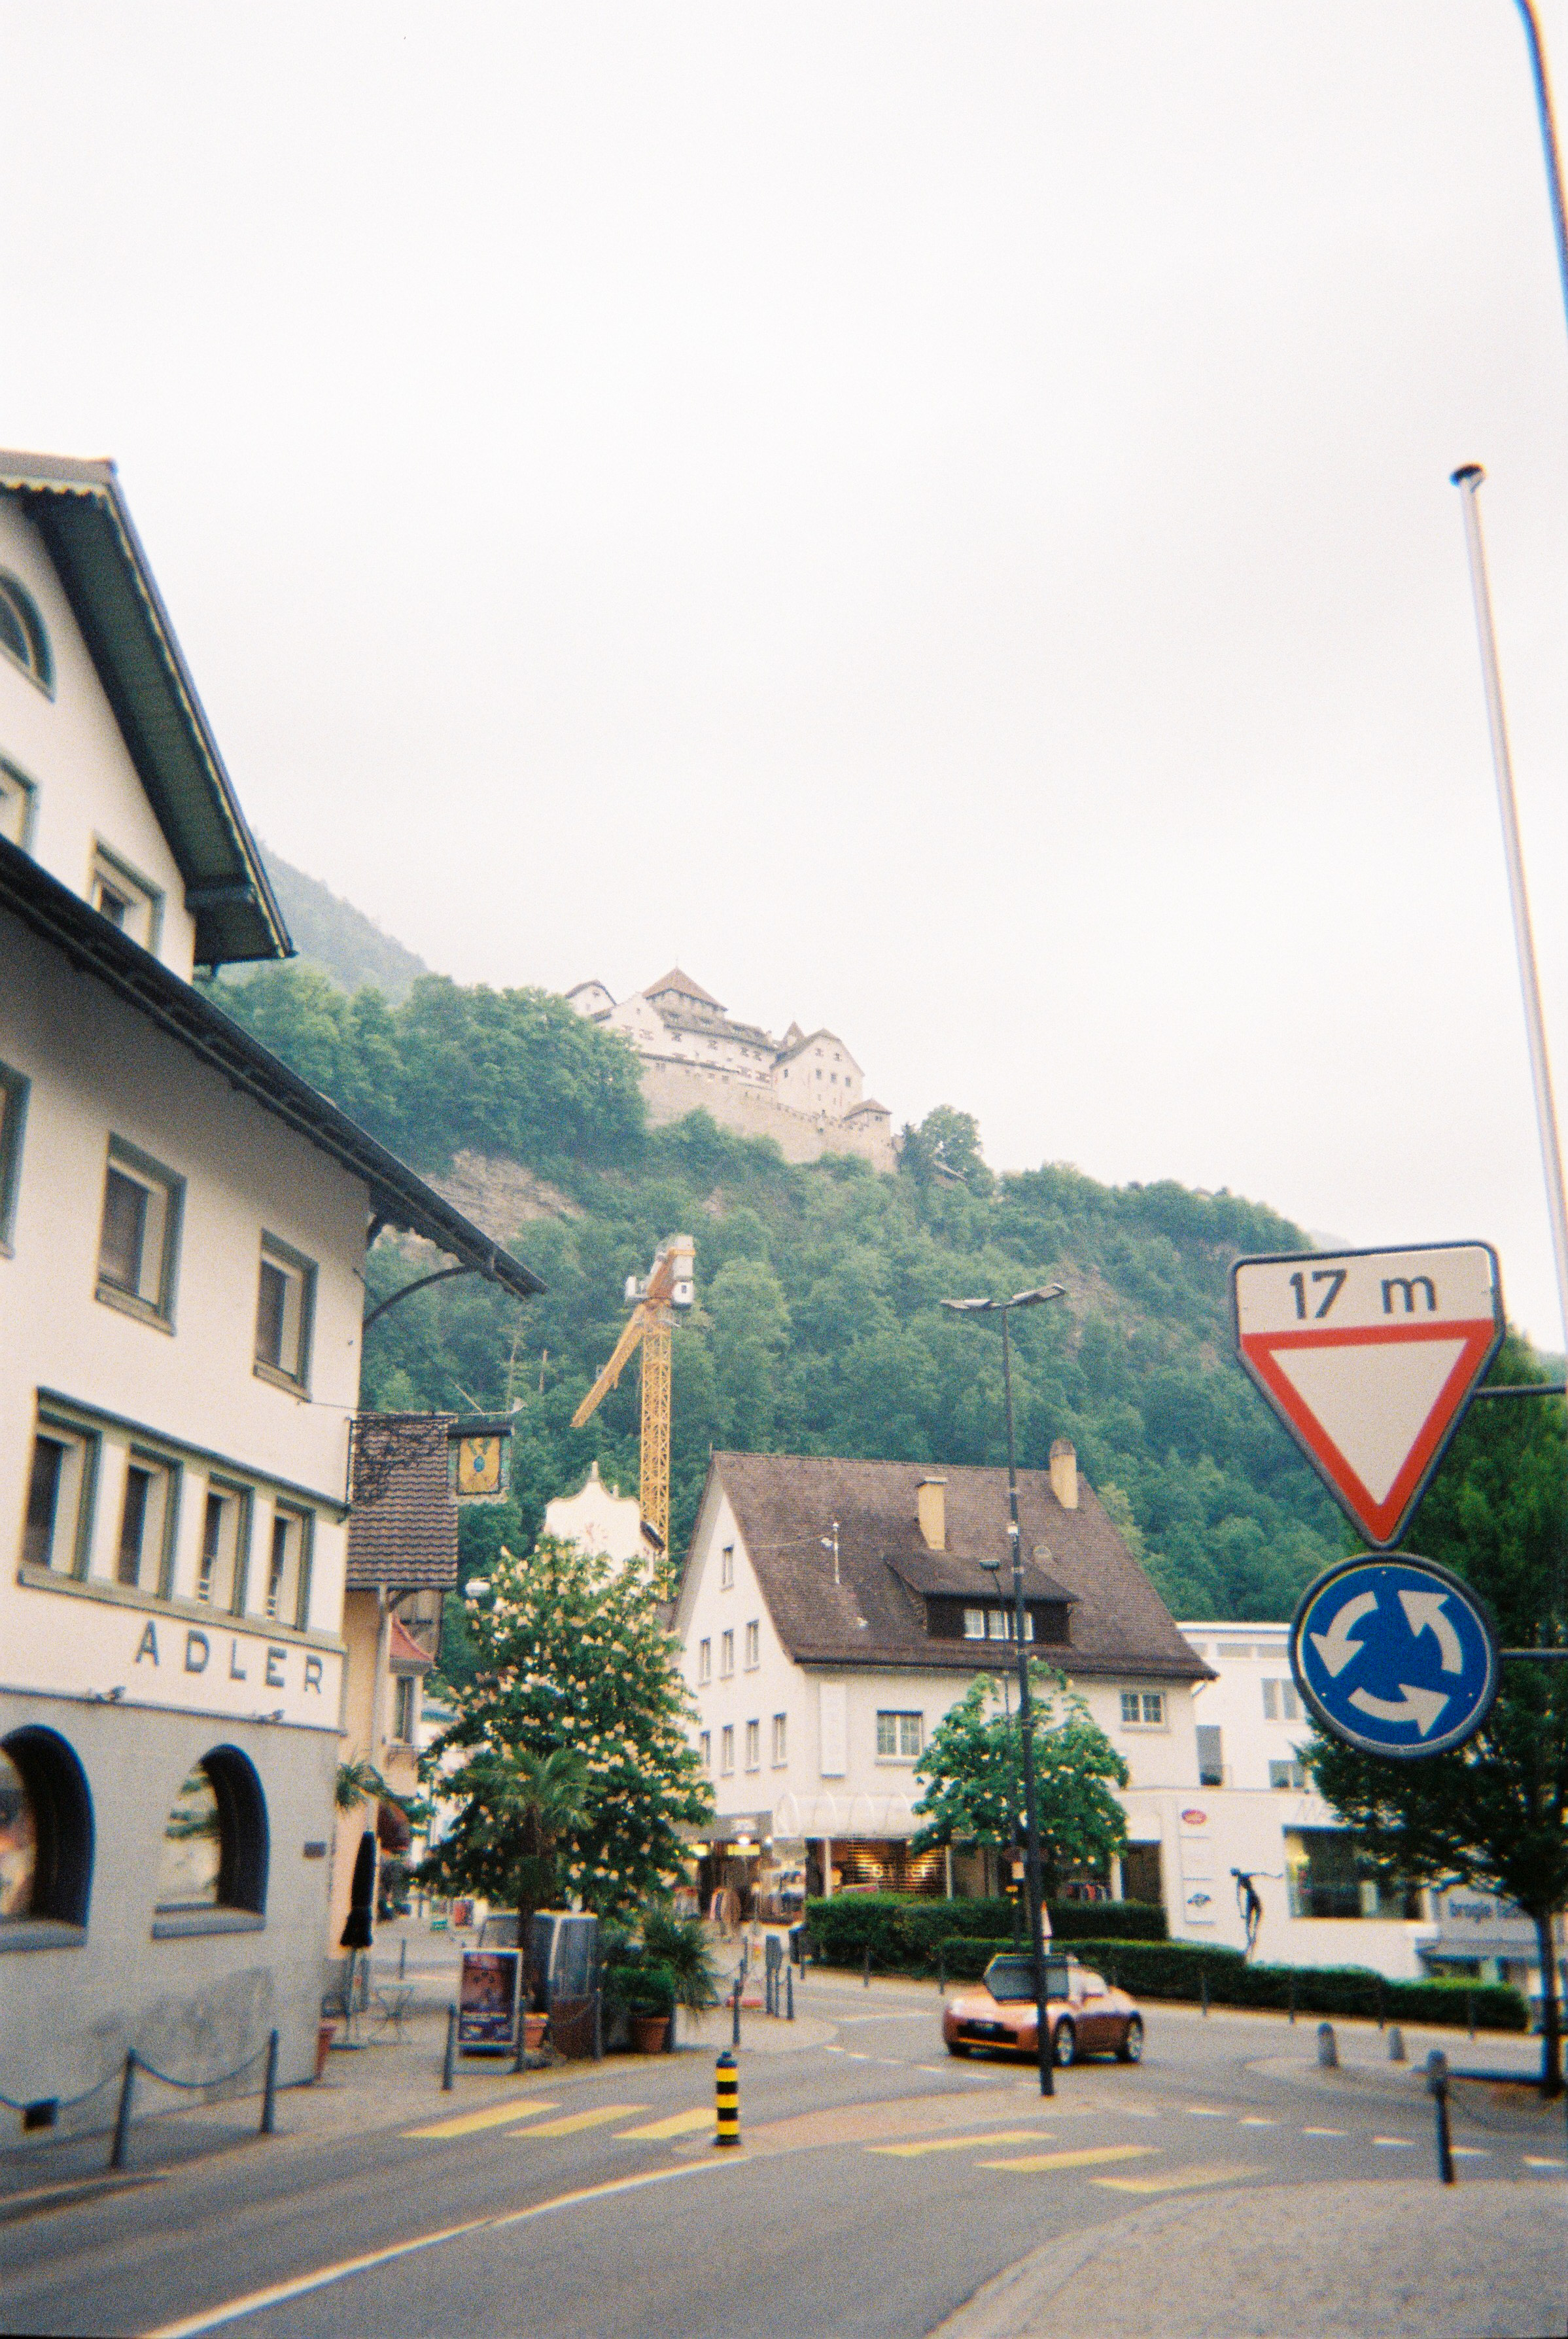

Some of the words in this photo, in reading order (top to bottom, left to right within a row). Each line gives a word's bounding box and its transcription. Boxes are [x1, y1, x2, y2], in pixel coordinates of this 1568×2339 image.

[1289, 1269, 1346, 1320] 17
[1381, 1276, 1437, 1314] m
[134, 1619, 324, 1694] ADLER
